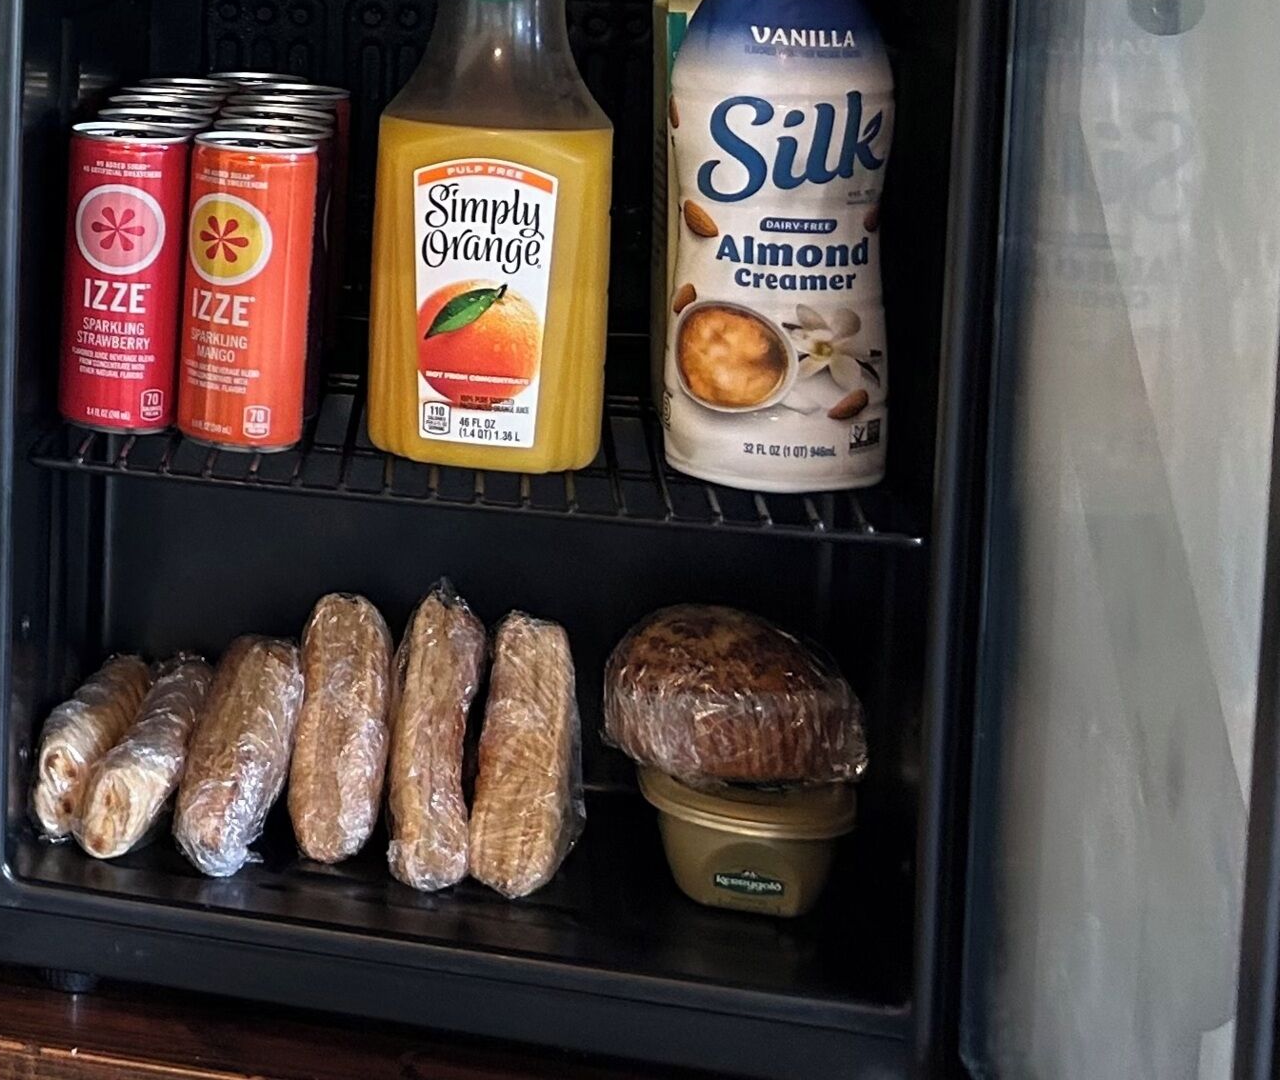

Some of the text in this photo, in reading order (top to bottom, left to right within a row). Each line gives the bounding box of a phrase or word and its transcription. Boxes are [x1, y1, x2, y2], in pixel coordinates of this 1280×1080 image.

[750, 25, 855, 48] VANILLA
[697, 90, 884, 203] Silk
[447, 165, 525, 180] PULP FREE
[425, 183, 545, 240] Simply
[766, 221, 832, 232] DAIRY-FREE
[422, 229, 541, 274] Orange
[715, 234, 869, 267] Almond
[734, 267, 857, 291] Creamer
[84, 278, 147, 313] IZZE
[193, 288, 250, 327] IZZE
[83, 317, 145, 336] SPARKLING
[77, 331, 151, 350] STRAWBERRY
[191, 328, 248, 349] SPARKLING
[197, 345, 236, 363] MANGO
[146, 392, 159, 406] 70
[250, 409, 266, 422] 70
[430, 405, 445, 416] 110
[459, 417, 496, 429] 46 FL OZ
[459, 428, 520, 441] (1.4 QT) 1.36 L
[743, 442, 754, 454] 32
[756, 444, 767, 455] FL
[769, 444, 781, 456] OZ
[783, 444, 791, 458] (1
[792, 445, 808, 459] QT)
[716, 873, 782, 893] Kerrygold
